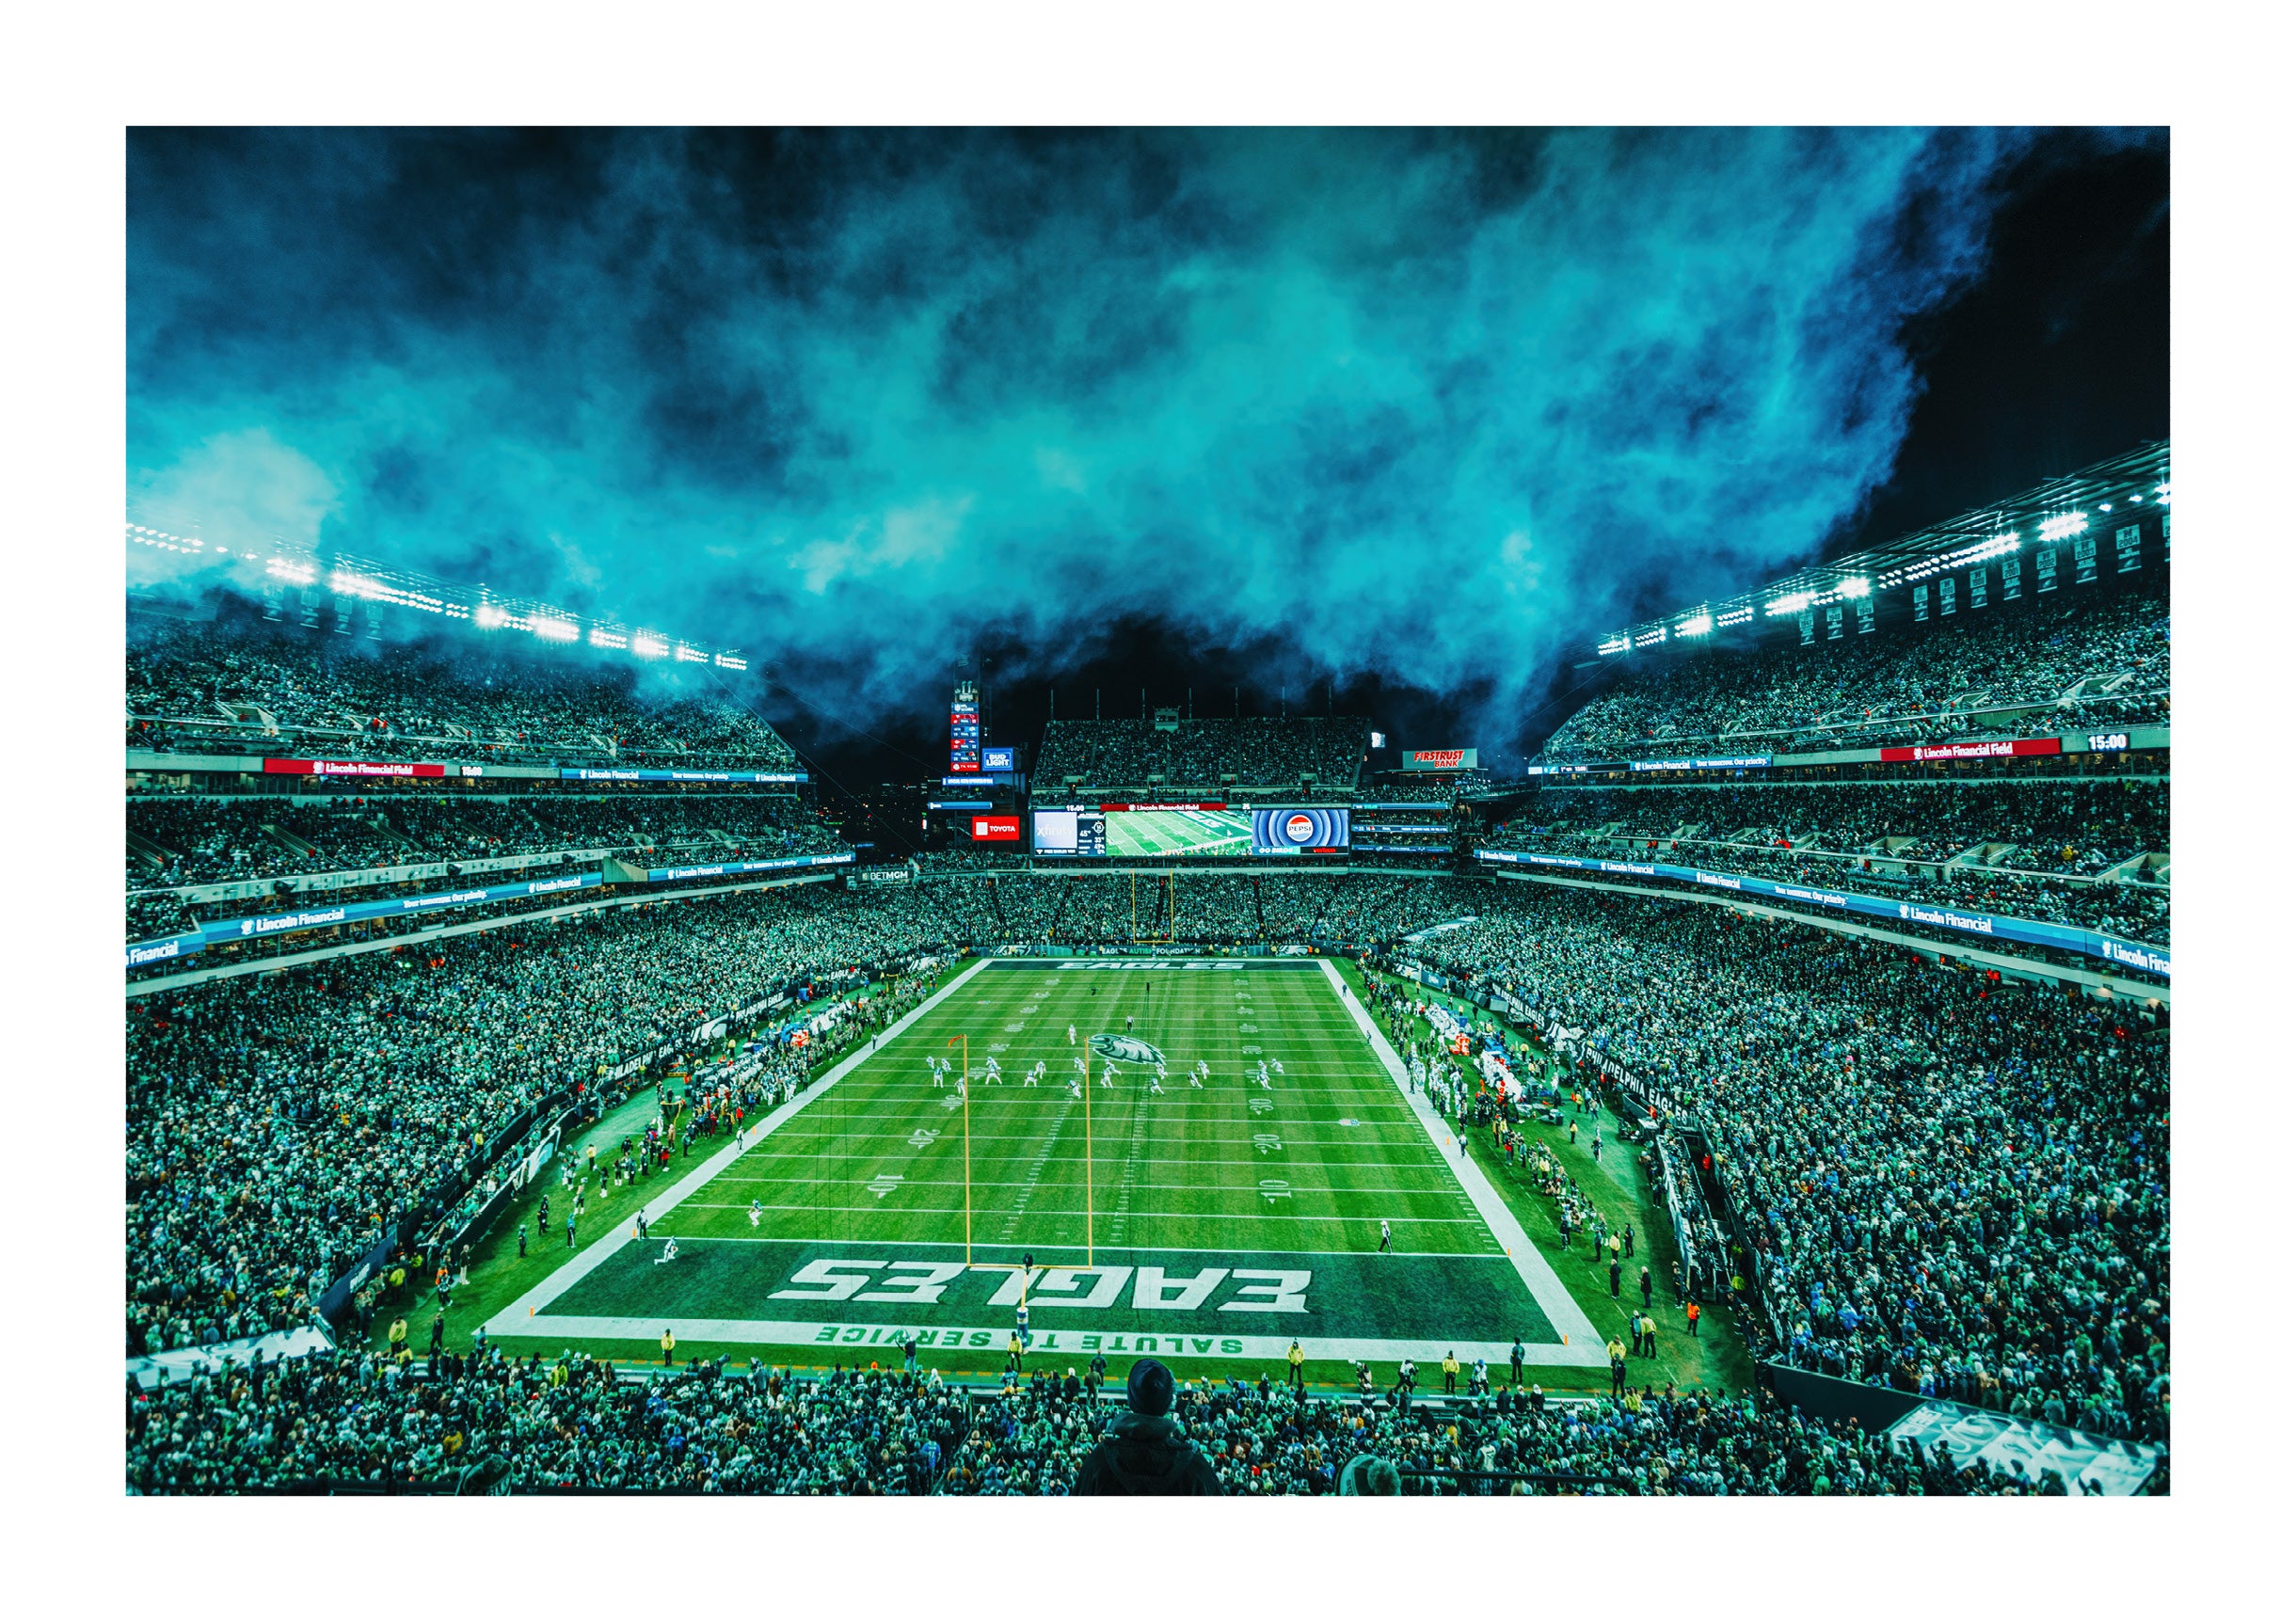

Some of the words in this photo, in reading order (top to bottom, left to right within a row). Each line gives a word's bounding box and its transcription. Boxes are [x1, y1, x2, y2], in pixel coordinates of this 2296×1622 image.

[1924, 747, 1953, 758] Lincoln
[1953, 744, 1989, 756] Financial
[1990, 742, 2013, 755] Field
[2088, 734, 2127, 750] 15:00
[1413, 750, 1464, 761] FIRSTRUST
[326, 763, 358, 773] Lincoln
[359, 764, 393, 774] Financial
[393, 765, 413, 775] Field
[1641, 761, 1663, 771] Lincoln
[1663, 760, 1690, 770] Financial
[588, 770, 612, 779] Lincoln
[612, 771, 639, 780] Financial
[1037, 823, 1074, 837] xfinity
[869, 870, 908, 881] BETMGM
[130, 940, 179, 962] Financial
[256, 915, 298, 933] Lincoln
[298, 907, 344, 926] Financial
[675, 867, 697, 878] Lincoln
[697, 865, 723, 876] Financial
[1606, 863, 1628, 872] Lincoln
[1627, 864, 1654, 875] Financial
[1701, 872, 1718, 884] Lincoln
[1718, 875, 1740, 889] Financial
[1910, 907, 1944, 925] Lincoln
[1945, 912, 1992, 933] Financial
[2113, 942, 2147, 968] Lincoln
[1057, 962, 1246, 970] EAGLES
[1249, 1098, 1274, 1111] 30
[1648, 1088, 1688, 1123] EAGES
[908, 1128, 941, 1145] 20
[1253, 1134, 1283, 1150] 20
[867, 1173, 905, 1192] 10
[1259, 1179, 1292, 1199] 10
[766, 1259, 1312, 1313] EAGLES
[1082, 1333, 1244, 1354] SALUTE
